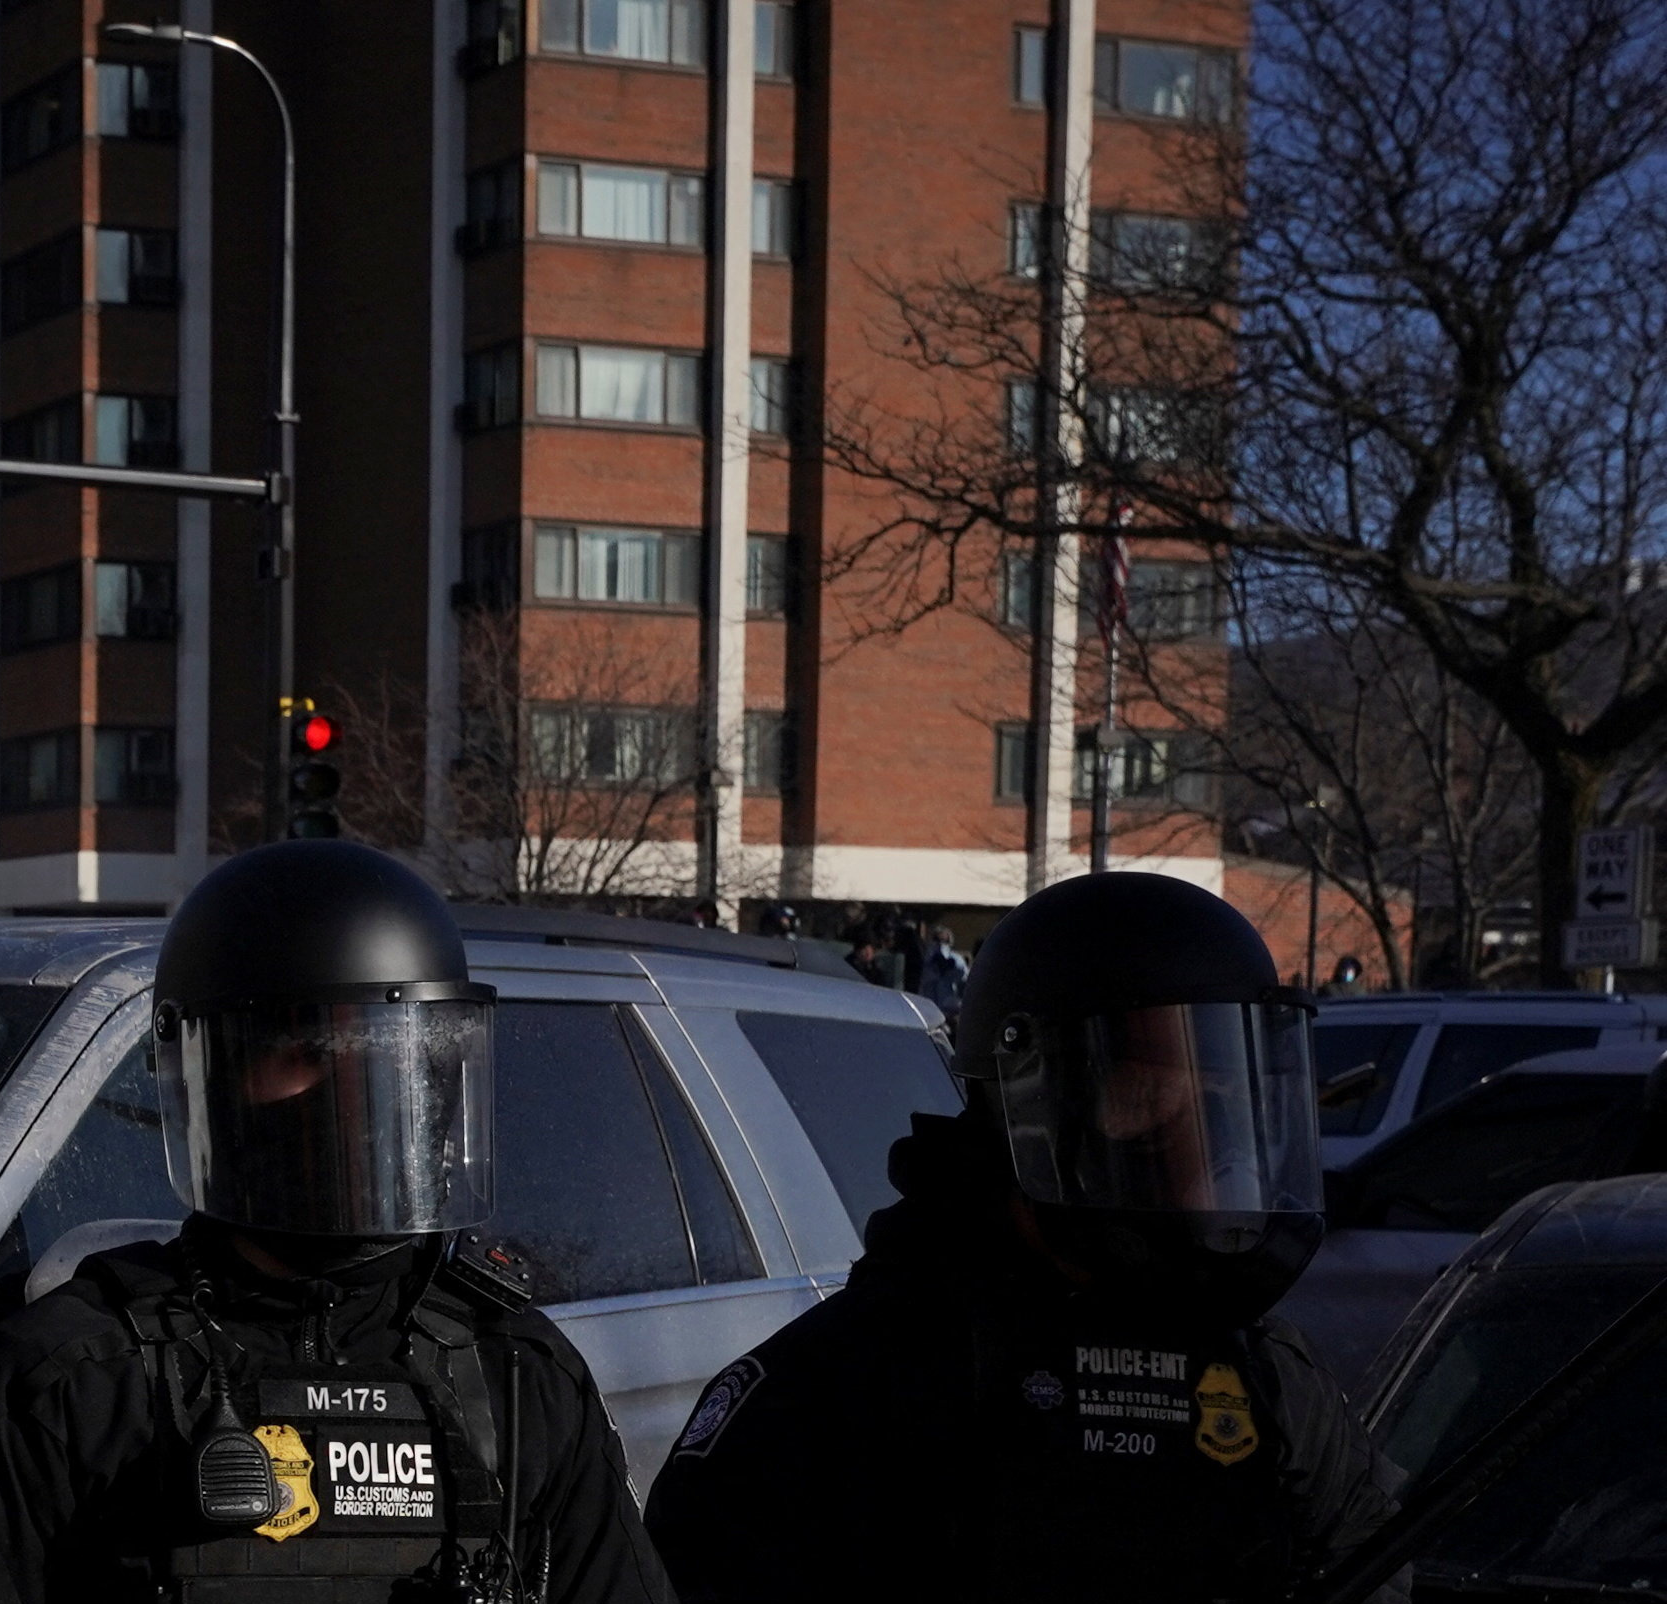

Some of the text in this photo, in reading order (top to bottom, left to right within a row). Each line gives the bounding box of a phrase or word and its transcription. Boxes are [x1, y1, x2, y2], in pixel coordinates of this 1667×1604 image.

[1587, 835, 1629, 857] ONE
[1586, 859, 1629, 879] WAY
[1075, 1346, 1188, 1381] POLICE-EMT
[306, 1386, 388, 1412] M-175
[1031, 1385, 1055, 1395] EMS
[1077, 1388, 1105, 1402] U.S.
[1106, 1390, 1169, 1406] CUSTOMS
[1171, 1398, 1190, 1409] AND
[1078, 1402, 1190, 1424] BORDER PROTECTION
[1083, 1428, 1156, 1456] M-200
[328, 1441, 435, 1484] POLICE
[357, 1487, 410, 1502] CUSTOMS
[410, 1490, 434, 1502] AND
[334, 1501, 434, 1518] BORDER PROTECTION
